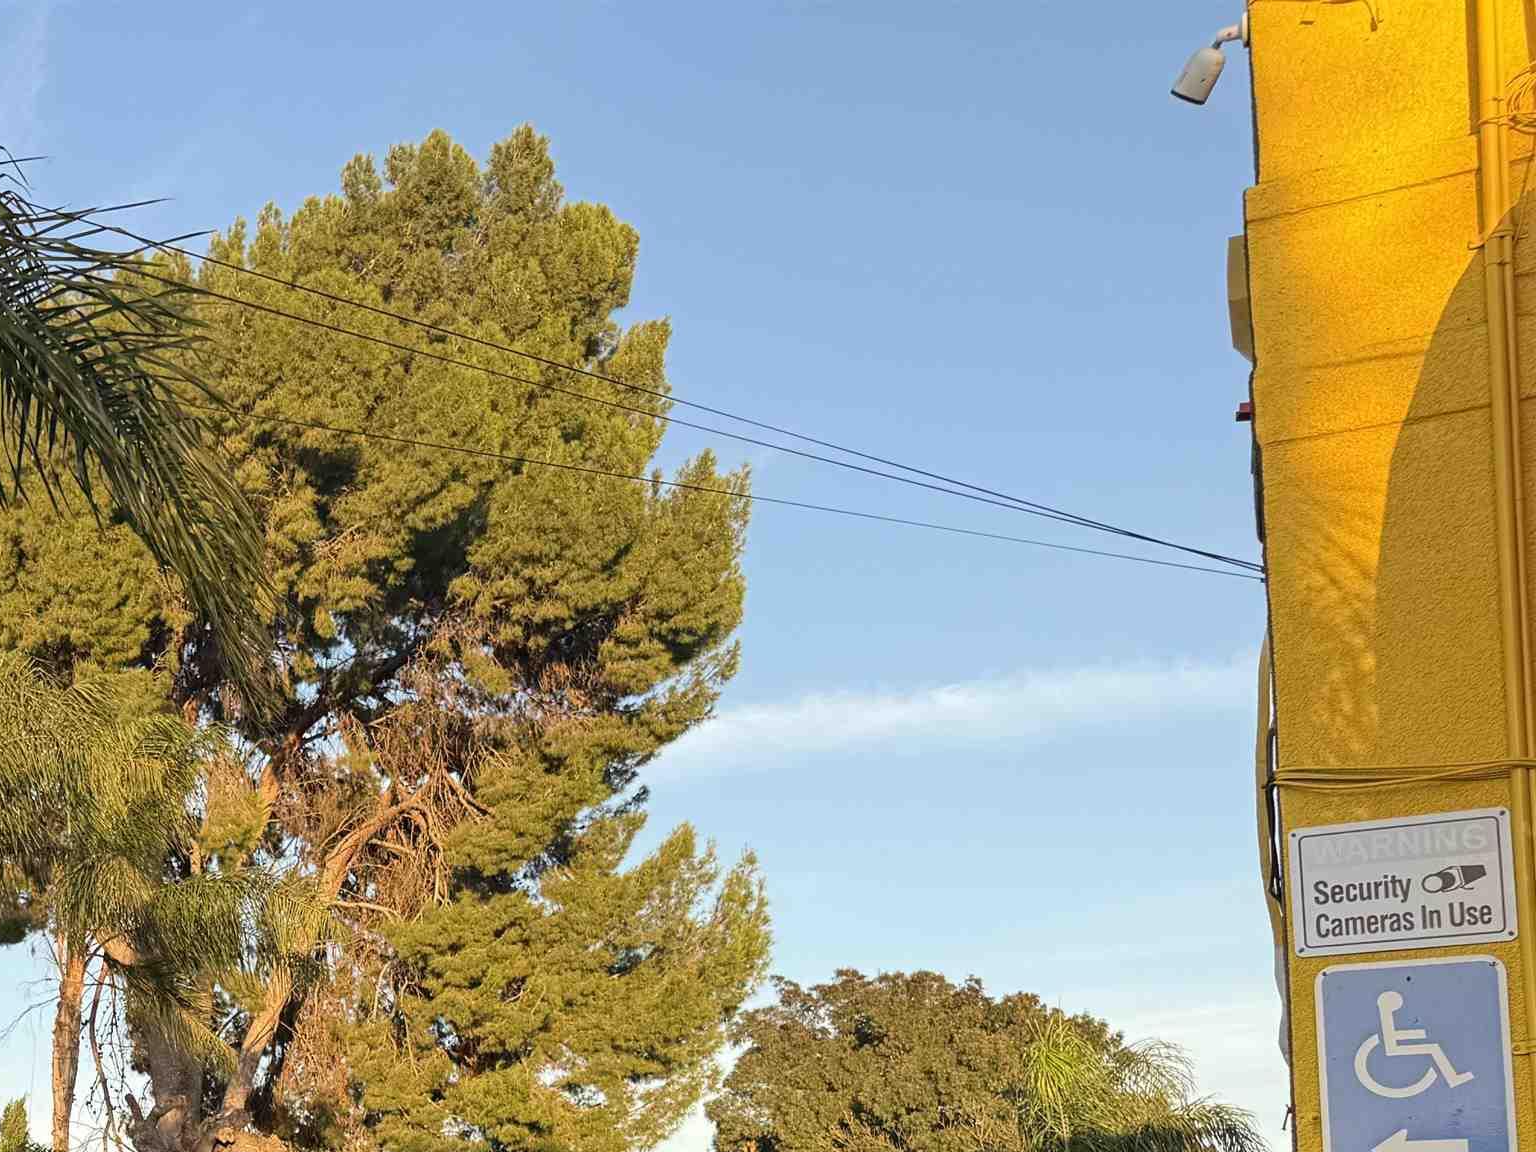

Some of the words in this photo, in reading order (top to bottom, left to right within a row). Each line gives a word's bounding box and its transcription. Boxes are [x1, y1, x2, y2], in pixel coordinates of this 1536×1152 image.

[1315, 823, 1489, 865] WARNING
[1314, 874, 1412, 905] Security
[1315, 910, 1415, 939] Cameras
[1421, 904, 1442, 930] In
[1449, 901, 1493, 927] Use
